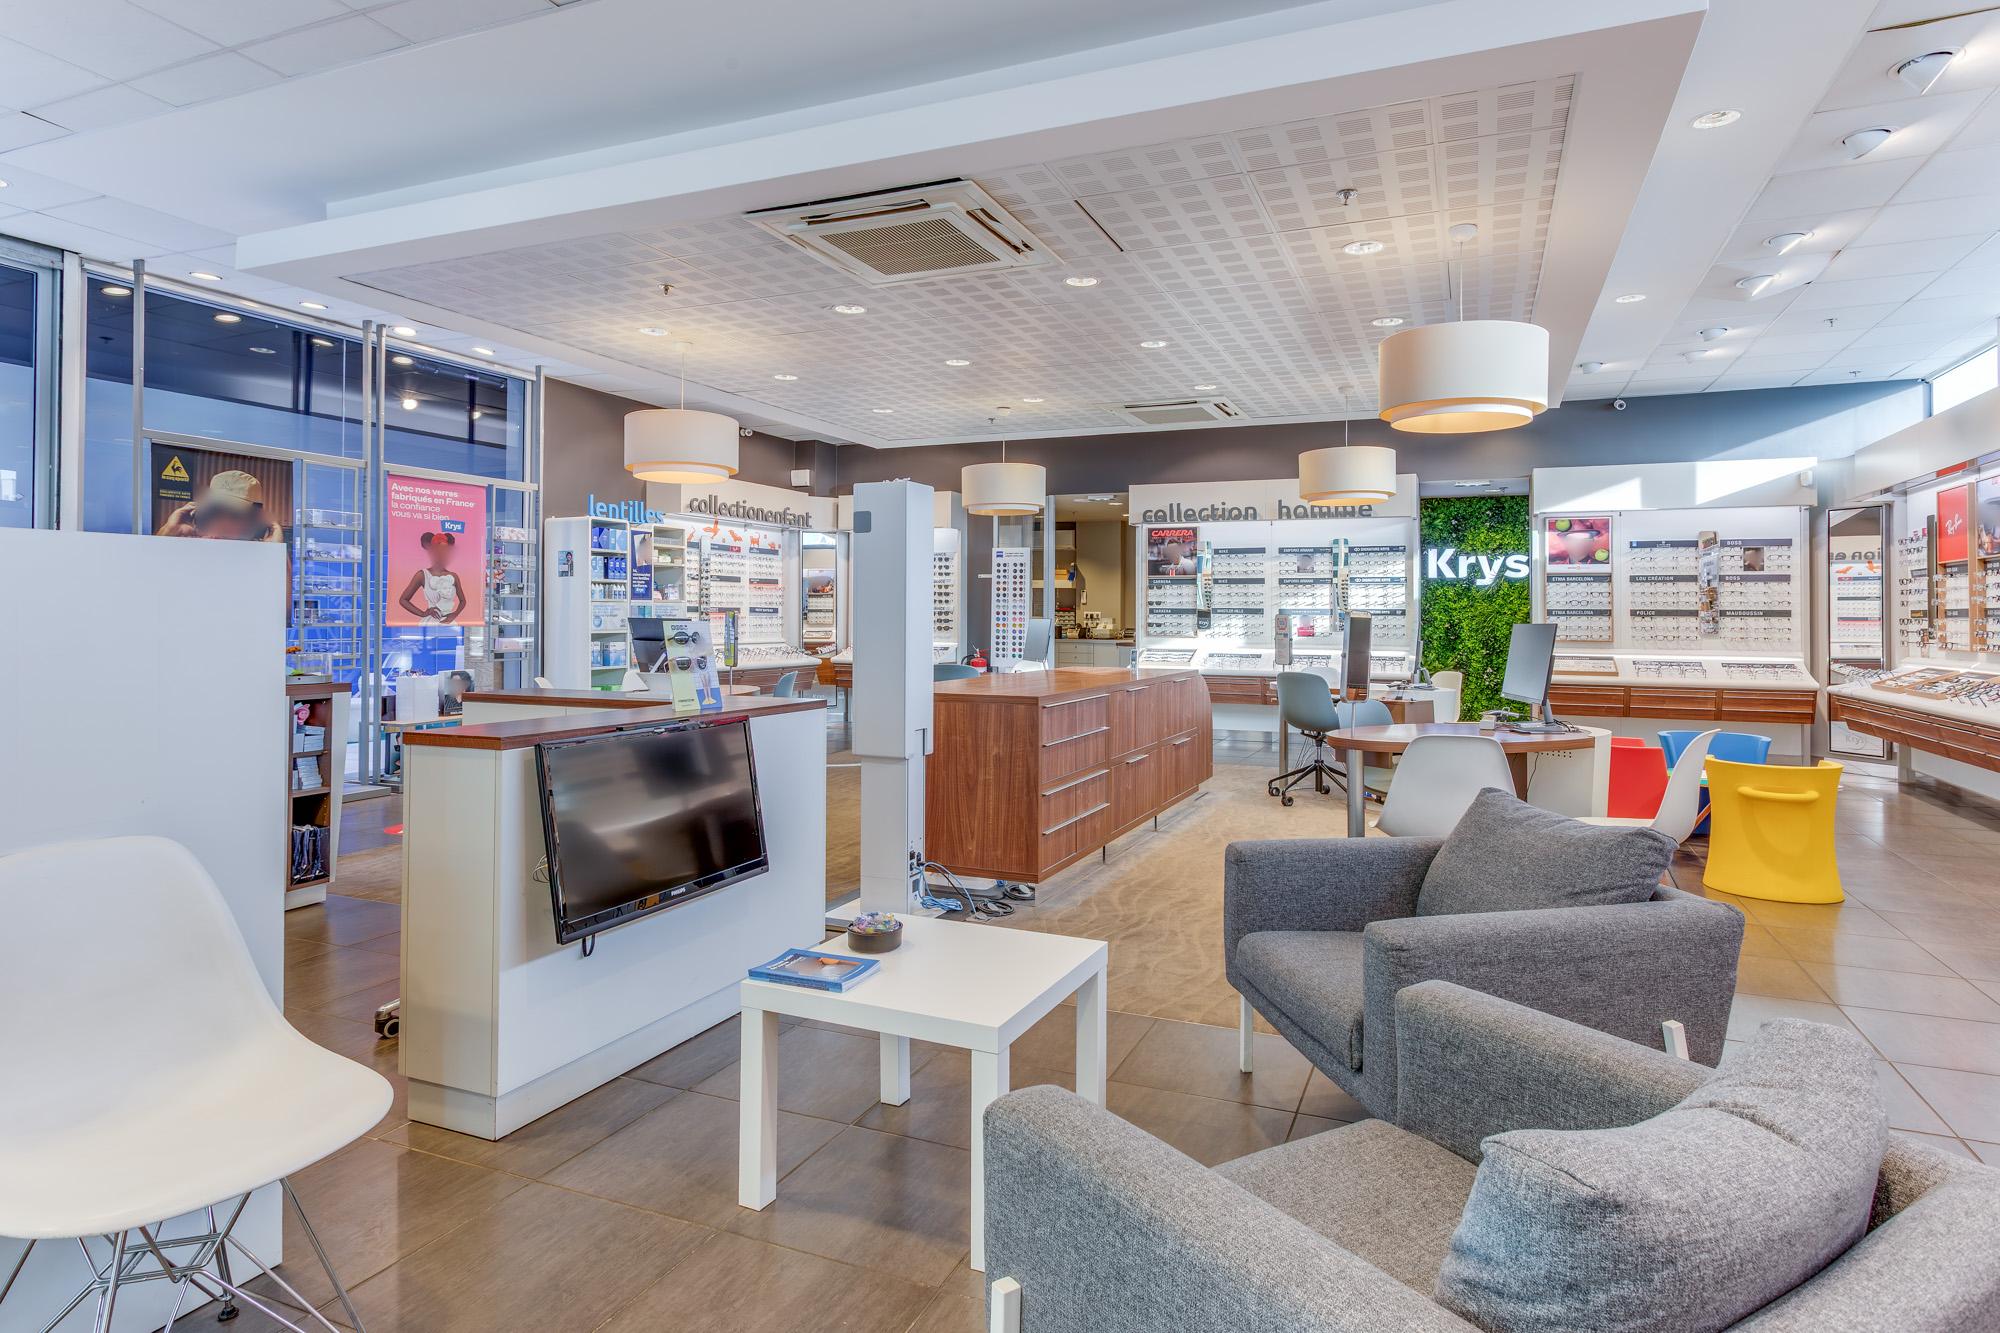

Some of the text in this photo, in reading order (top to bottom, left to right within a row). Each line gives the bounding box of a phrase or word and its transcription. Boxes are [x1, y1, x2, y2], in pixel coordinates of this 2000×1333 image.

[391, 482, 414, 492] Avec
[432, 489, 458, 498] verres
[392, 492, 432, 504] fabriqués
[392, 500, 440, 512] la confiance
[588, 494, 666, 524] lentilles
[1142, 500, 1373, 522] collection homme
[445, 522, 462, 530] Krys
[1428, 548, 1530, 585] Krys
